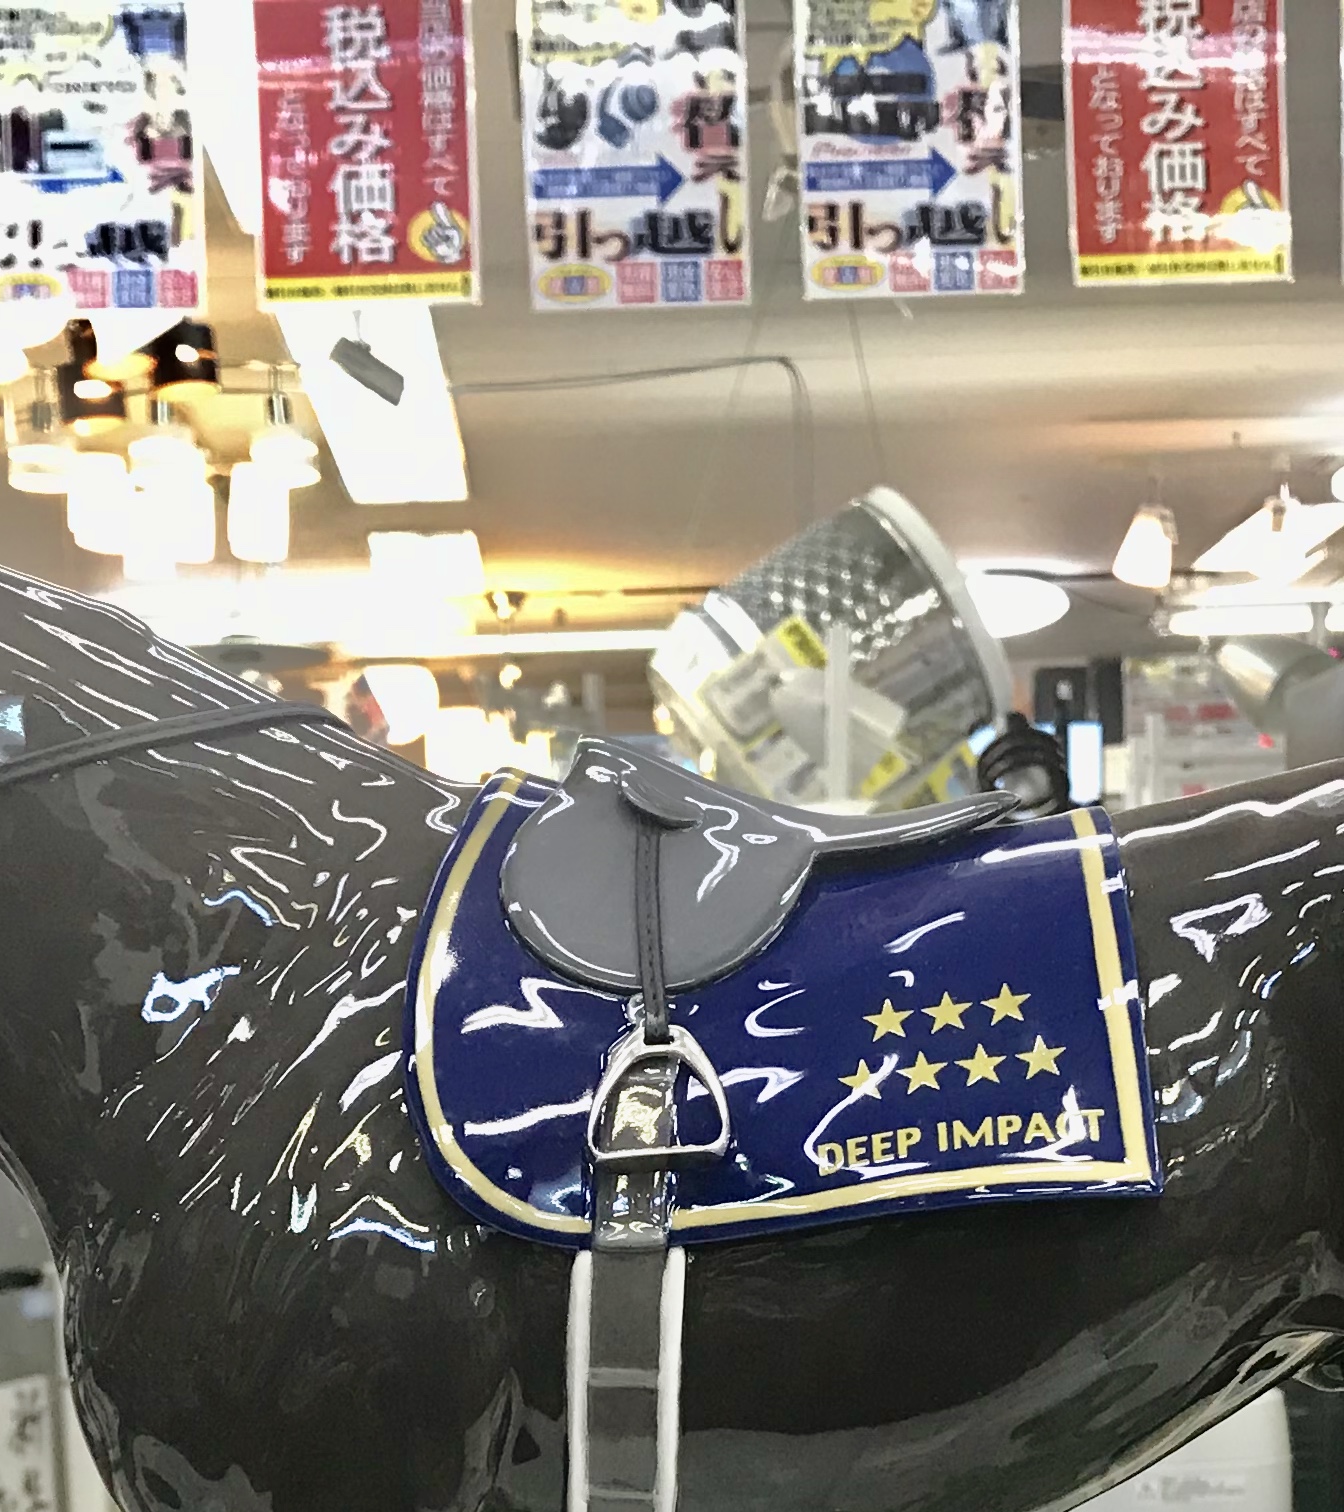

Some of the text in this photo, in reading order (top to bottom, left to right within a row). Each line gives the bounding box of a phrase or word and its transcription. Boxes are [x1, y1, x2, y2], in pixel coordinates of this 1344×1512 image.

[320, 3, 397, 264] 税込み価格
[534, 182, 744, 262] 引っ越し
[807, 172, 1016, 252] 引っ越し
[817, 1108, 1105, 1177] DEEP IMPACT
